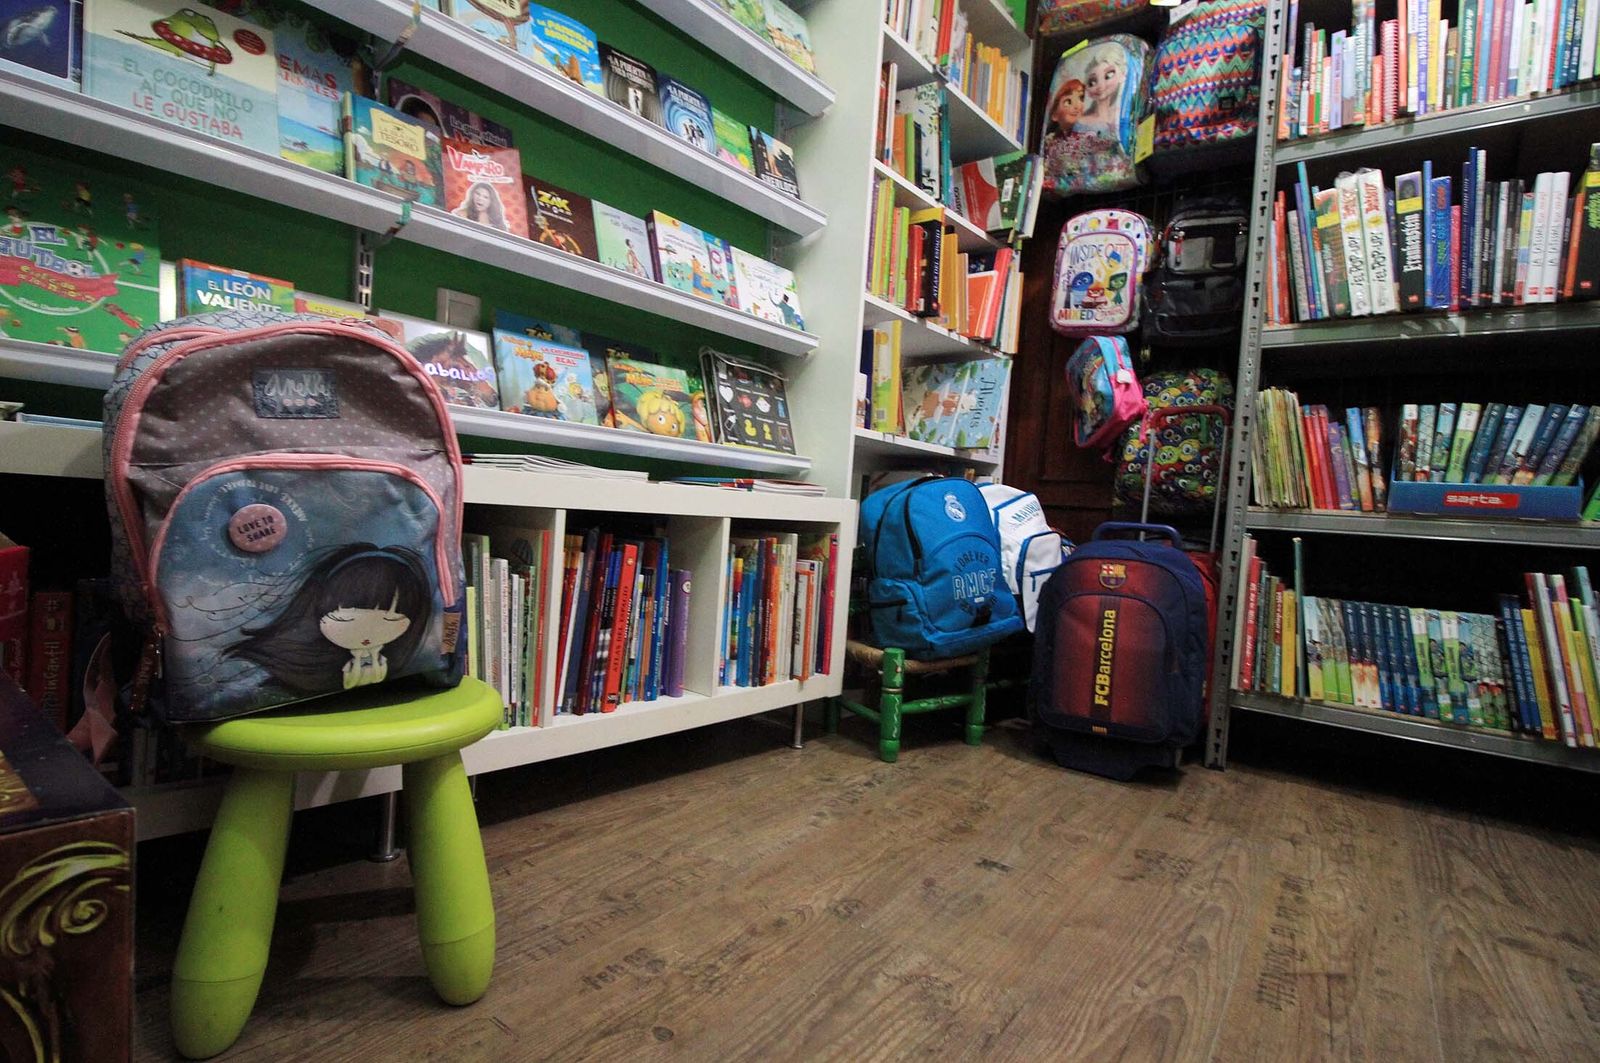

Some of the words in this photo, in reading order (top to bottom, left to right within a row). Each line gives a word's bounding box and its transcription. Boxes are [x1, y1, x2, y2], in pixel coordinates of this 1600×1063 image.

[123, 58, 144, 77] EL
[153, 69, 253, 113] COCODRILO
[139, 79, 163, 98] AL
[171, 89, 207, 113] QUE
[213, 102, 238, 122] NO
[131, 91, 154, 112] LE
[162, 102, 244, 140] GUSTABA
[760, 172, 799, 196] SHERLOCK
[30, 224, 66, 245] EL
[1403, 213, 1424, 273] Frankenstein
[1070, 244, 1104, 265] INSIDE
[207, 280, 223, 292] EL
[223, 280, 272, 301] LEÓN
[1058, 309, 1094, 321] MIXED
[1446, 494, 1501, 506] safta
[237, 519, 262, 535] LOVE
[262, 514, 275, 526] TO
[247, 526, 277, 543] SHARE
[951, 567, 997, 601] RMCF
[618, 586, 629, 622] ESPACIO
[616, 626, 624, 642] DEL
[612, 645, 621, 672] ATLAS
